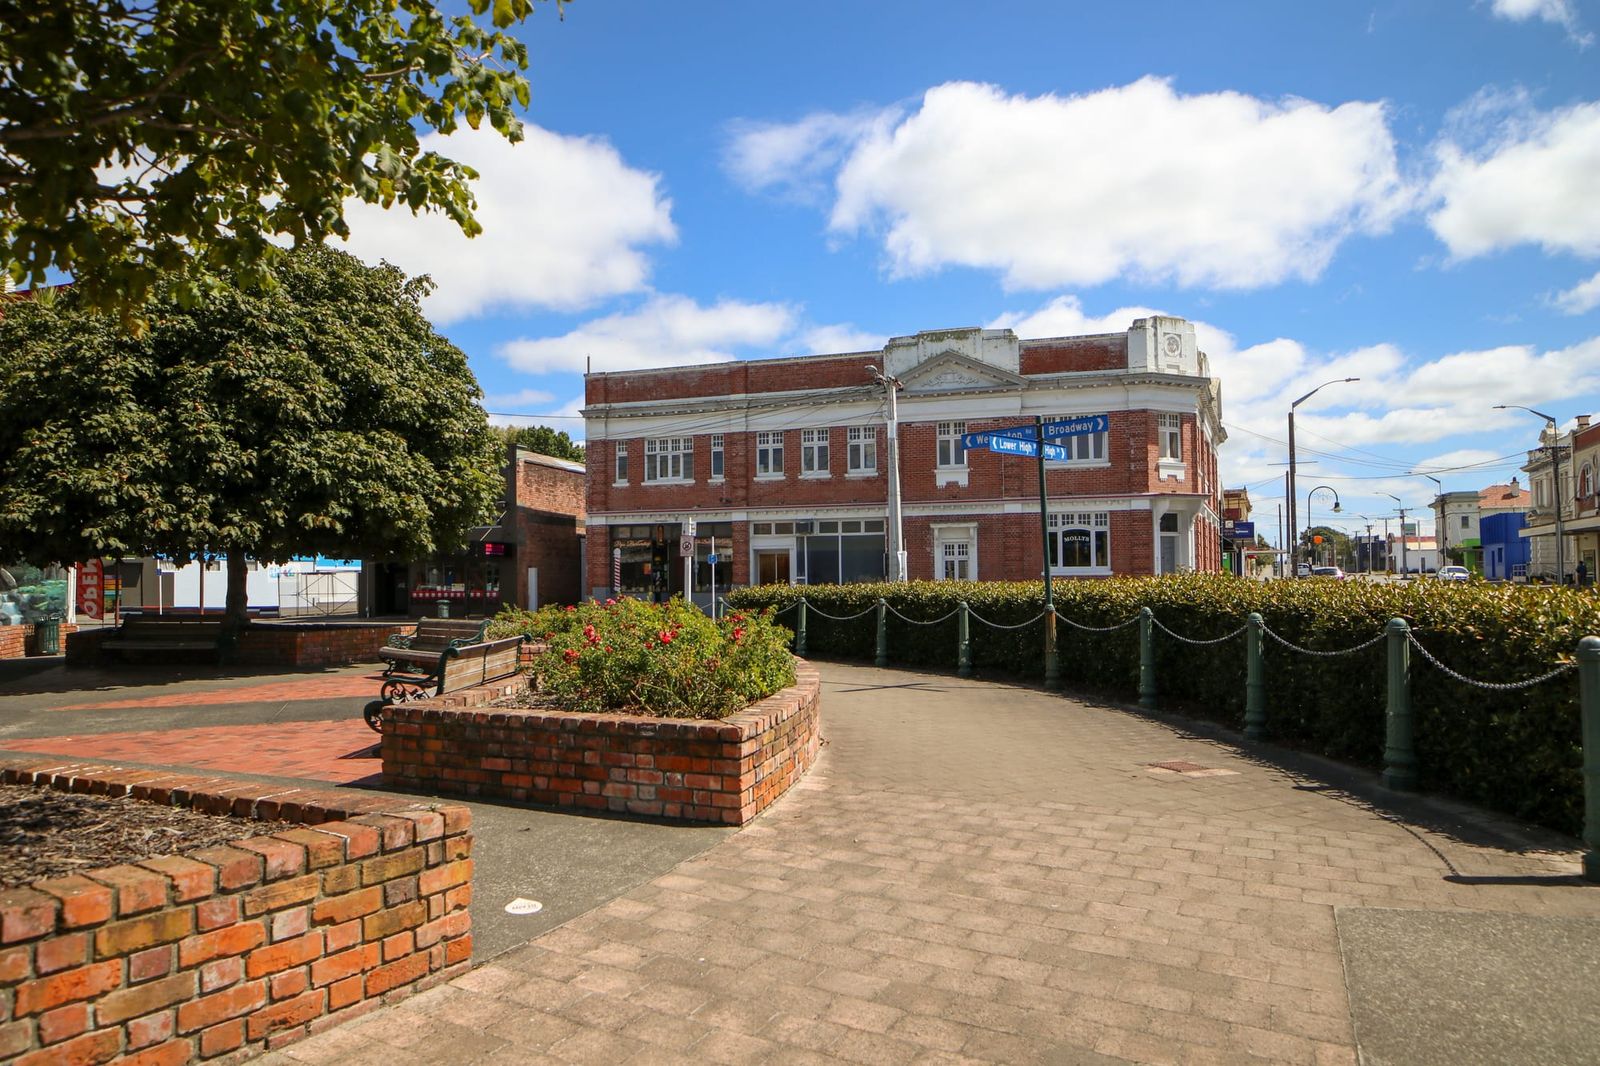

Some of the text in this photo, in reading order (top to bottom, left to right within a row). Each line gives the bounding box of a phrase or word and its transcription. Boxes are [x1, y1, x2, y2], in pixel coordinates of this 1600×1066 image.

[1048, 421, 1094, 436] Broadway
[976, 430, 1023, 444] Weton
[999, 438, 1017, 451] Lower
[1019, 441, 1033, 455] High
[1044, 444, 1056, 459] High
